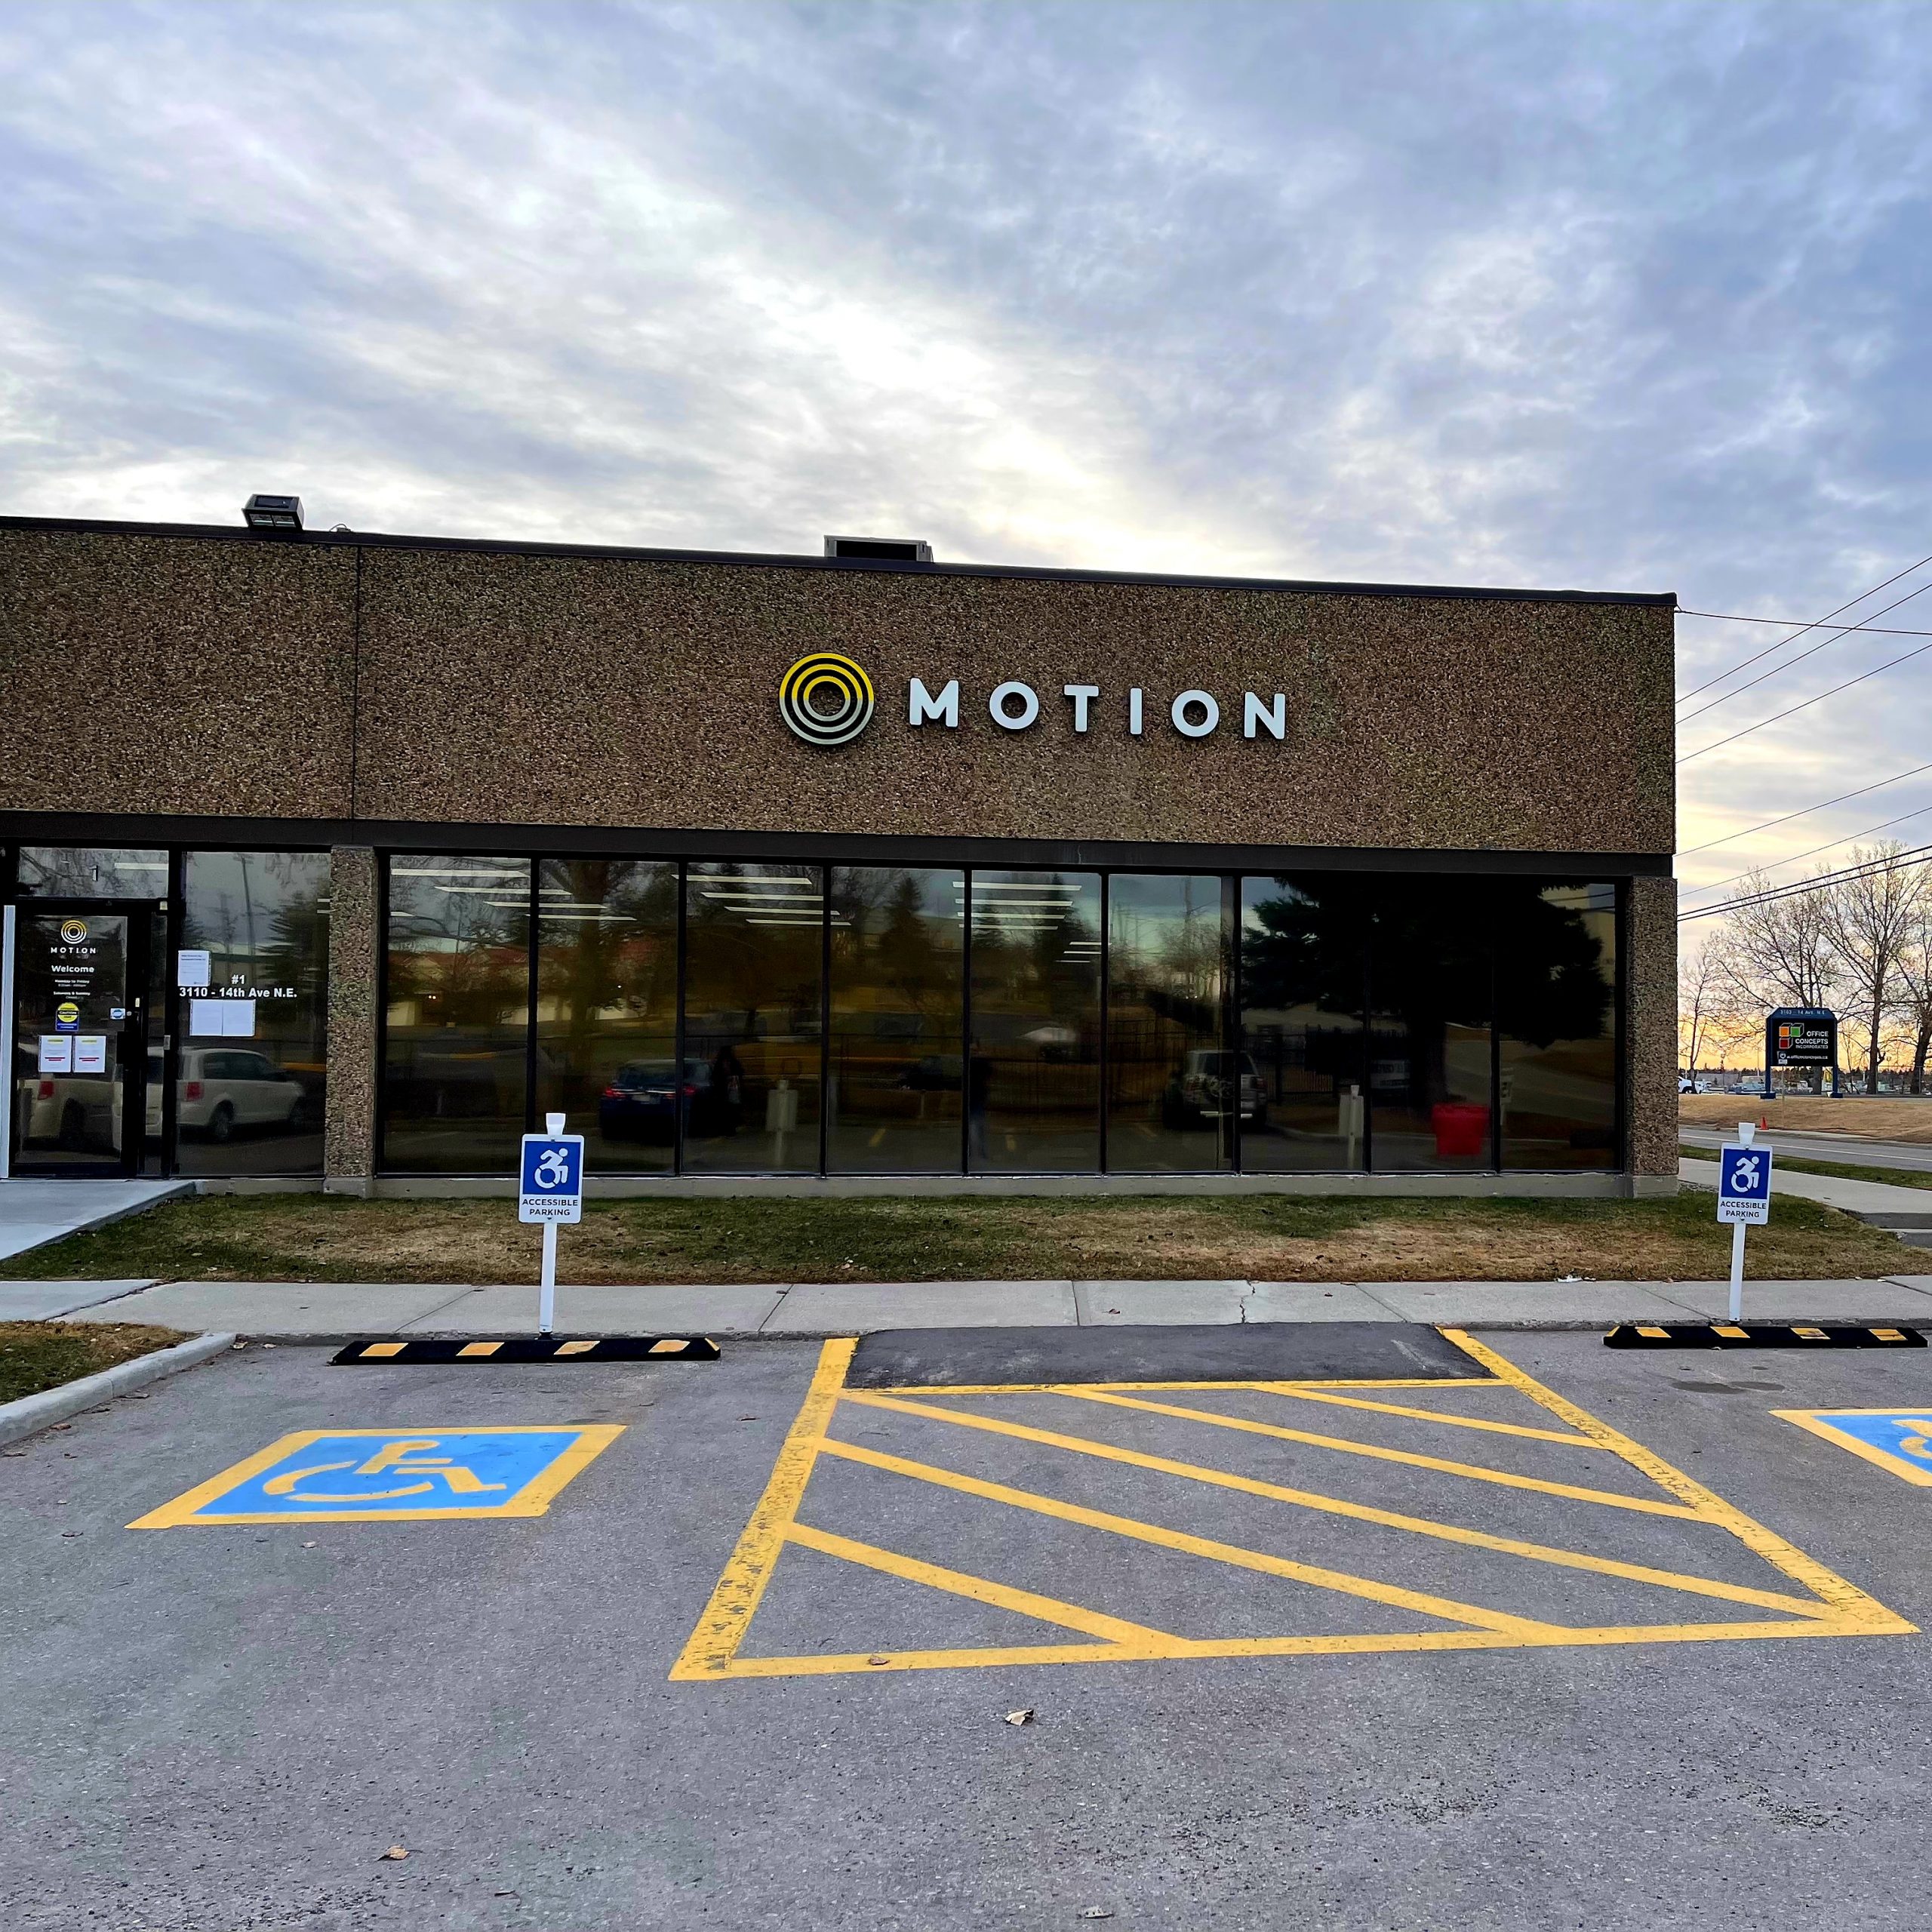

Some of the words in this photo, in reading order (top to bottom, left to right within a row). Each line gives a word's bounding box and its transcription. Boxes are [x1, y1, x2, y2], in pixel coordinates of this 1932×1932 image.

[909, 676, 1286, 740] MOTION
[51, 964, 95, 973] Welcome
[231, 974, 246, 984] #1
[179, 987, 208, 997] 3110
[219, 987, 245, 997] 14th
[248, 988, 270, 998] Ave
[273, 988, 297, 998] N.E.
[521, 1198, 579, 1207] ACCESSIBLE
[1721, 1201, 1767, 1209] ACCESSIBLE
